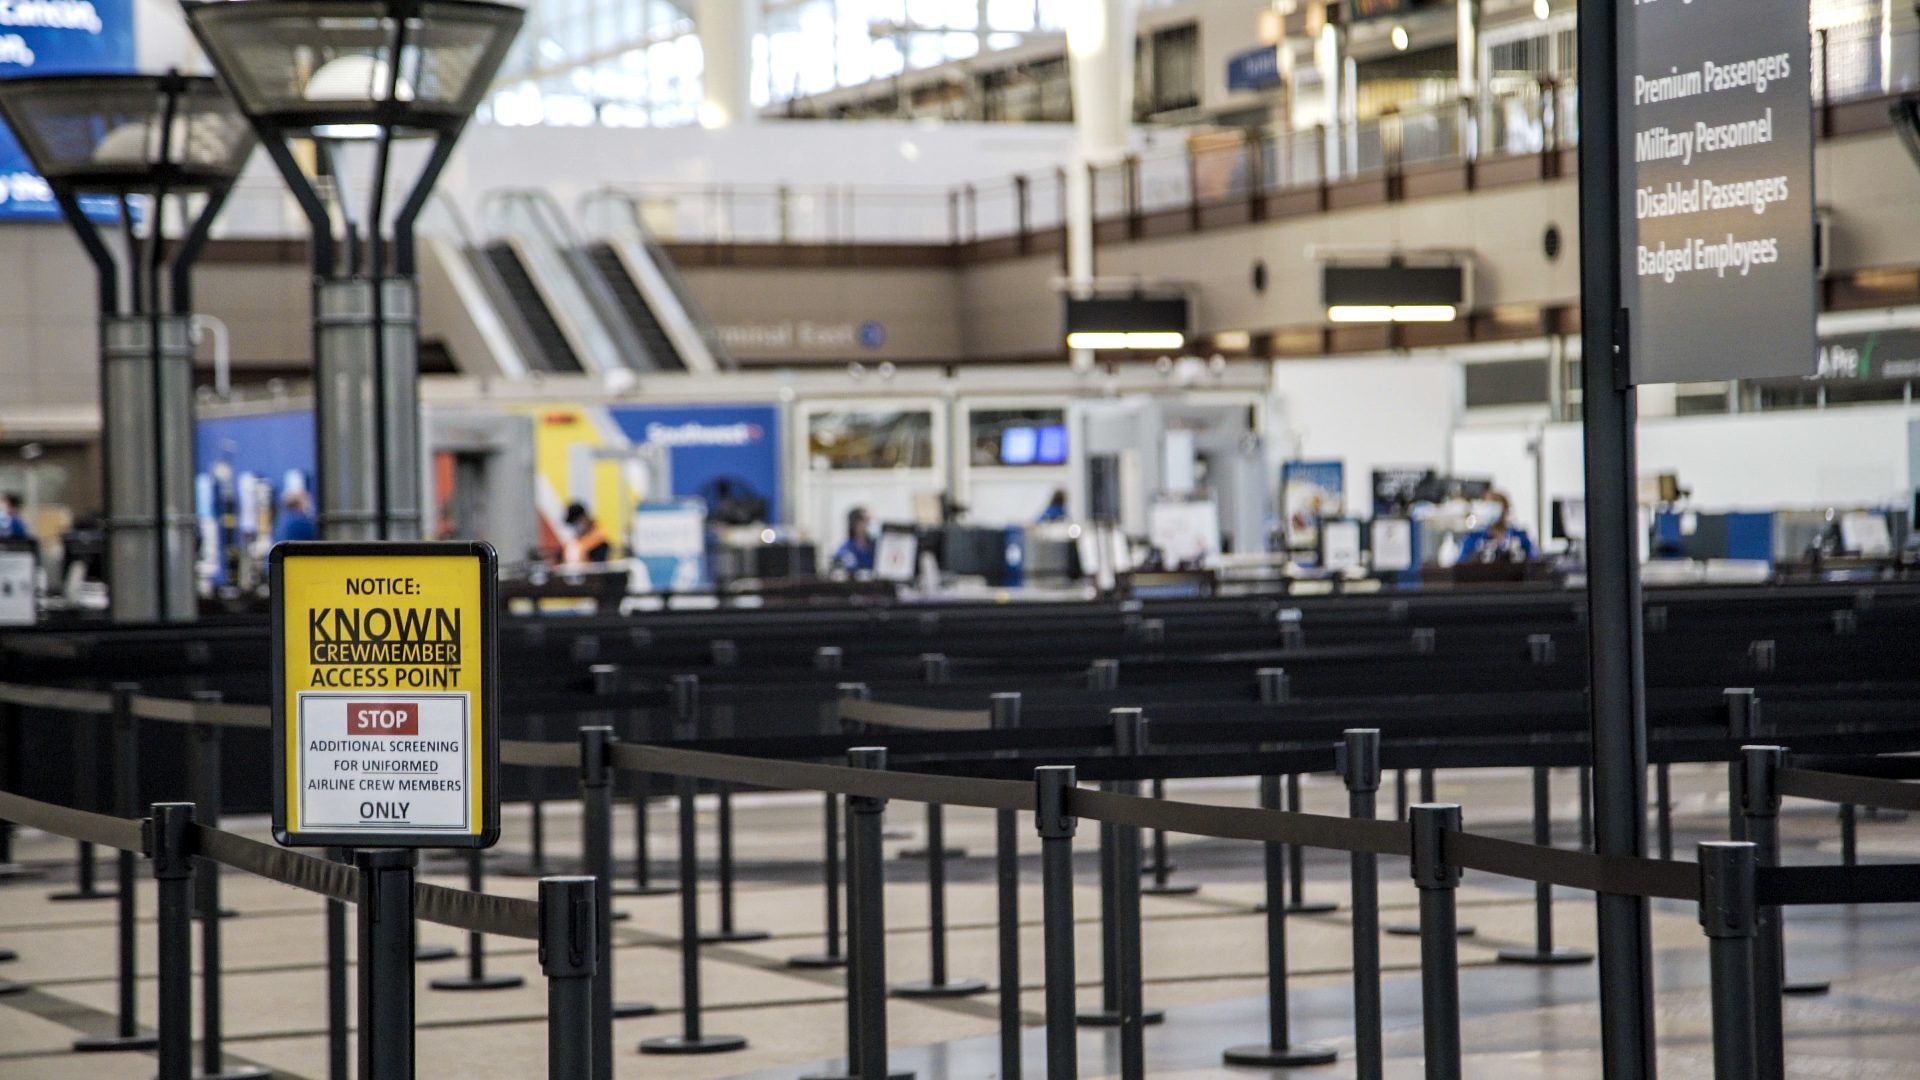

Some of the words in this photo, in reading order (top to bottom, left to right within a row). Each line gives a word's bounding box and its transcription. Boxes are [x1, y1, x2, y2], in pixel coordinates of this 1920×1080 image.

[1634, 66, 1702, 105] Premium
[1703, 53, 1790, 93] Passengers
[1635, 126, 1694, 165] Military
[1695, 107, 1772, 152] Personnel
[1636, 179, 1700, 219] Disabled
[1702, 176, 1788, 215] Passengers
[1637, 238, 1692, 283] Badged
[1694, 233, 1778, 277] Employees
[346, 578, 421, 595] NOTICE:
[309, 608, 460, 643] KNOWN
[313, 643, 457, 662] CREWMEMBER
[311, 667, 389, 687] ACCESS
[395, 668, 461, 688] POINT
[357, 709, 408, 729] STOP
[309, 740, 386, 752] ADDITIONAL
[389, 740, 459, 753] SCREENING
[334, 759, 358, 772] FOR
[362, 760, 438, 774] UNIFORMED
[308, 778, 355, 791] AIRLINE
[358, 779, 395, 791] CREW
[398, 779, 462, 792] MEMBERS
[359, 801, 411, 820] ONLY
